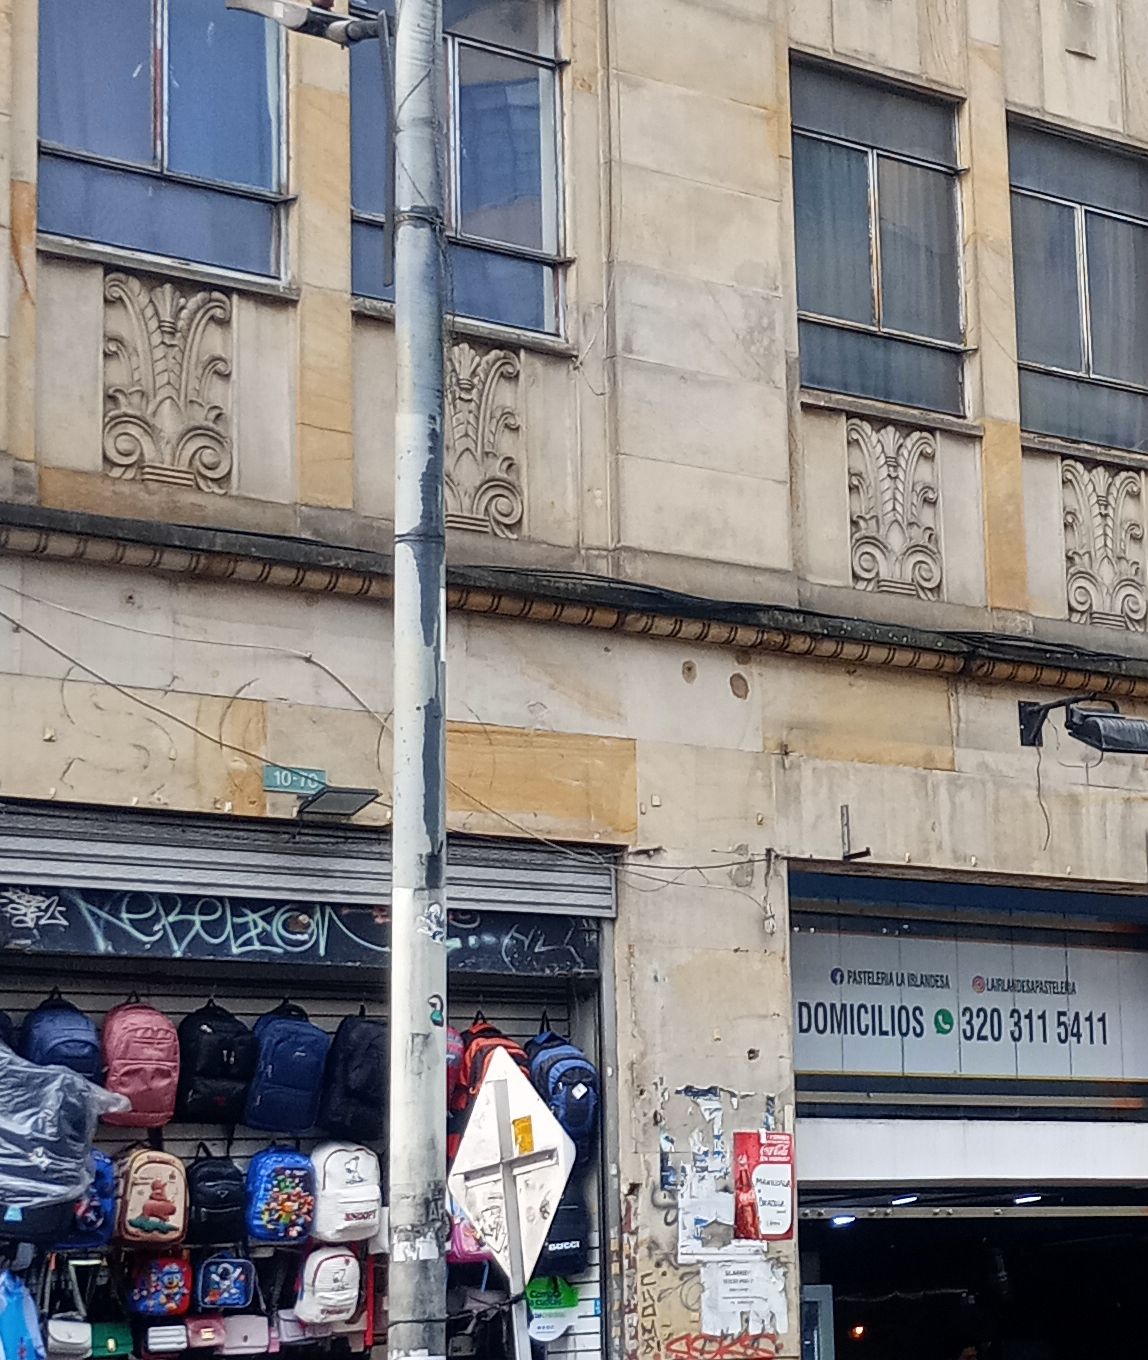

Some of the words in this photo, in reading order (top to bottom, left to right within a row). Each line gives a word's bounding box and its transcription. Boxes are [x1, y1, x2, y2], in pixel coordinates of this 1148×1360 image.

[797, 1001, 924, 1038] DOMICILIOS
[961, 1006, 1002, 1042] 320
[1009, 1008, 1048, 1044] 311
[1056, 1010, 1108, 1045] 5411
